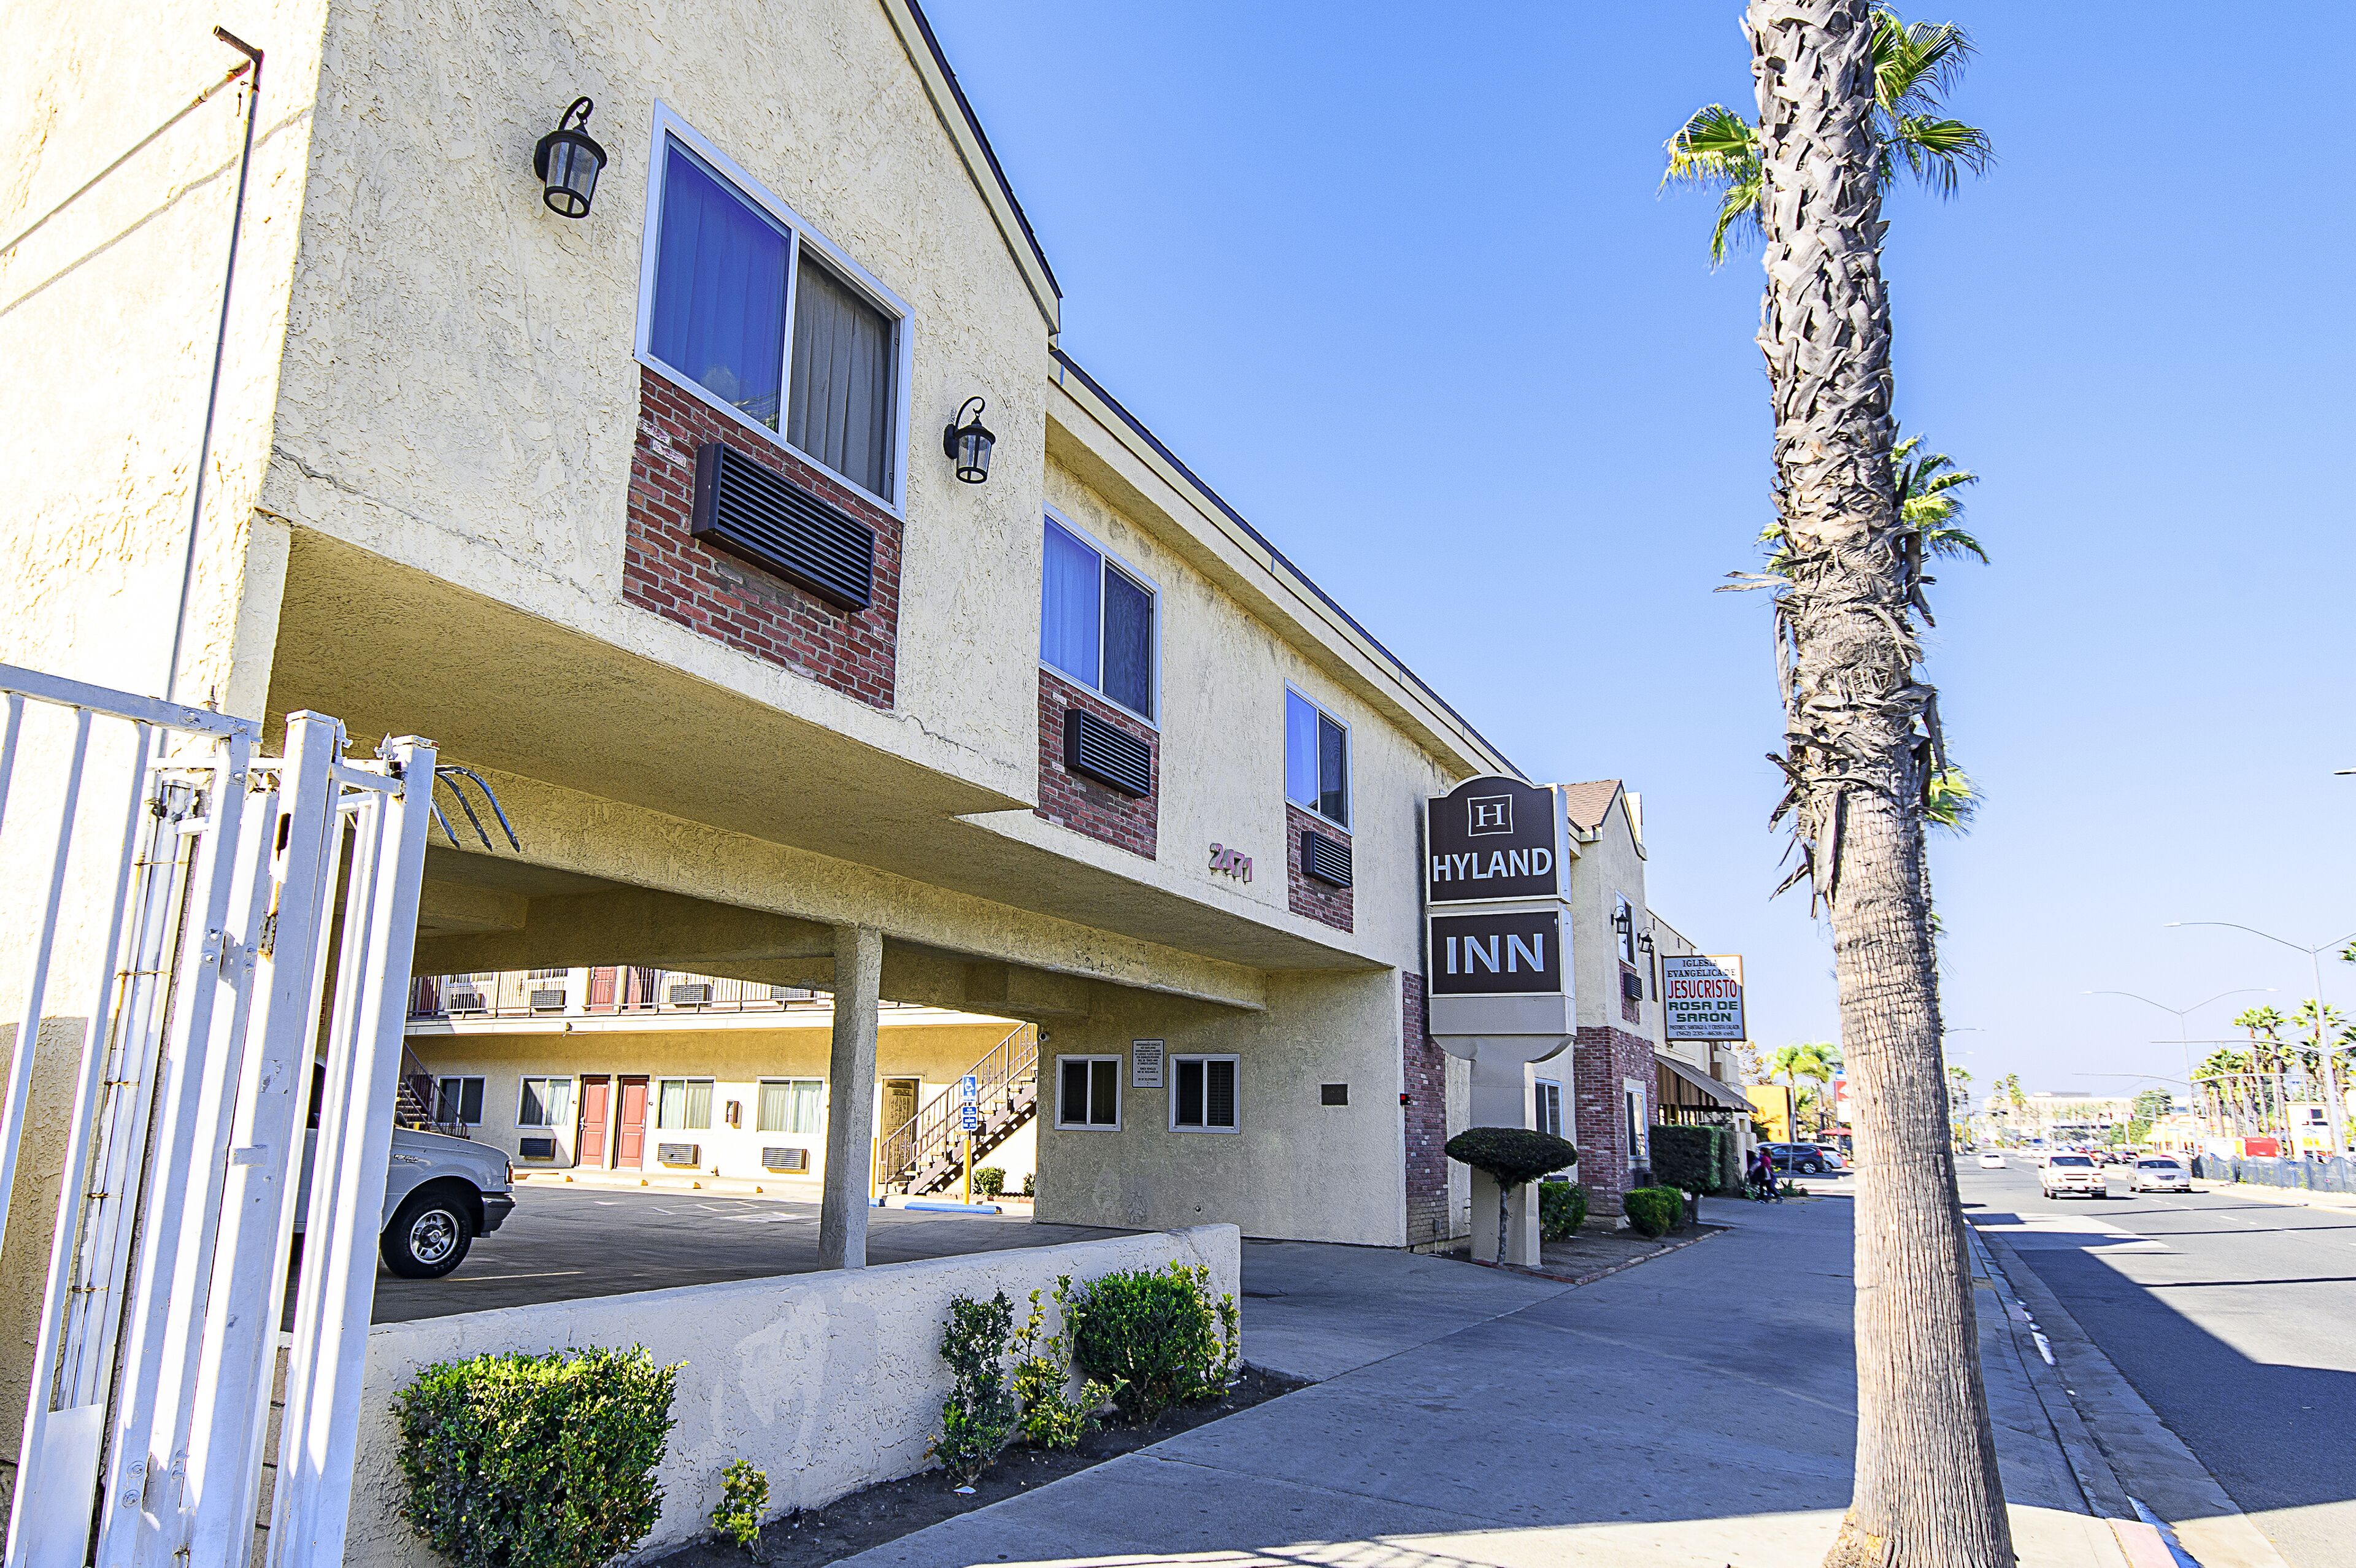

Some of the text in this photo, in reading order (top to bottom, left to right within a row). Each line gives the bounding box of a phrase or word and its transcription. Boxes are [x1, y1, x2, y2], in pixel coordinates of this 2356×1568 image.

[1475, 803, 1506, 828] H
[1209, 843, 1252, 882] 2471
[1433, 847, 1553, 882] HYLAND
[1446, 933, 1544, 974] INN
[1668, 979, 1737, 999] JESUCRISTO
[1669, 1001, 1738, 1010] ROSA DE
[1676, 1010, 1732, 1022] SARÓN
